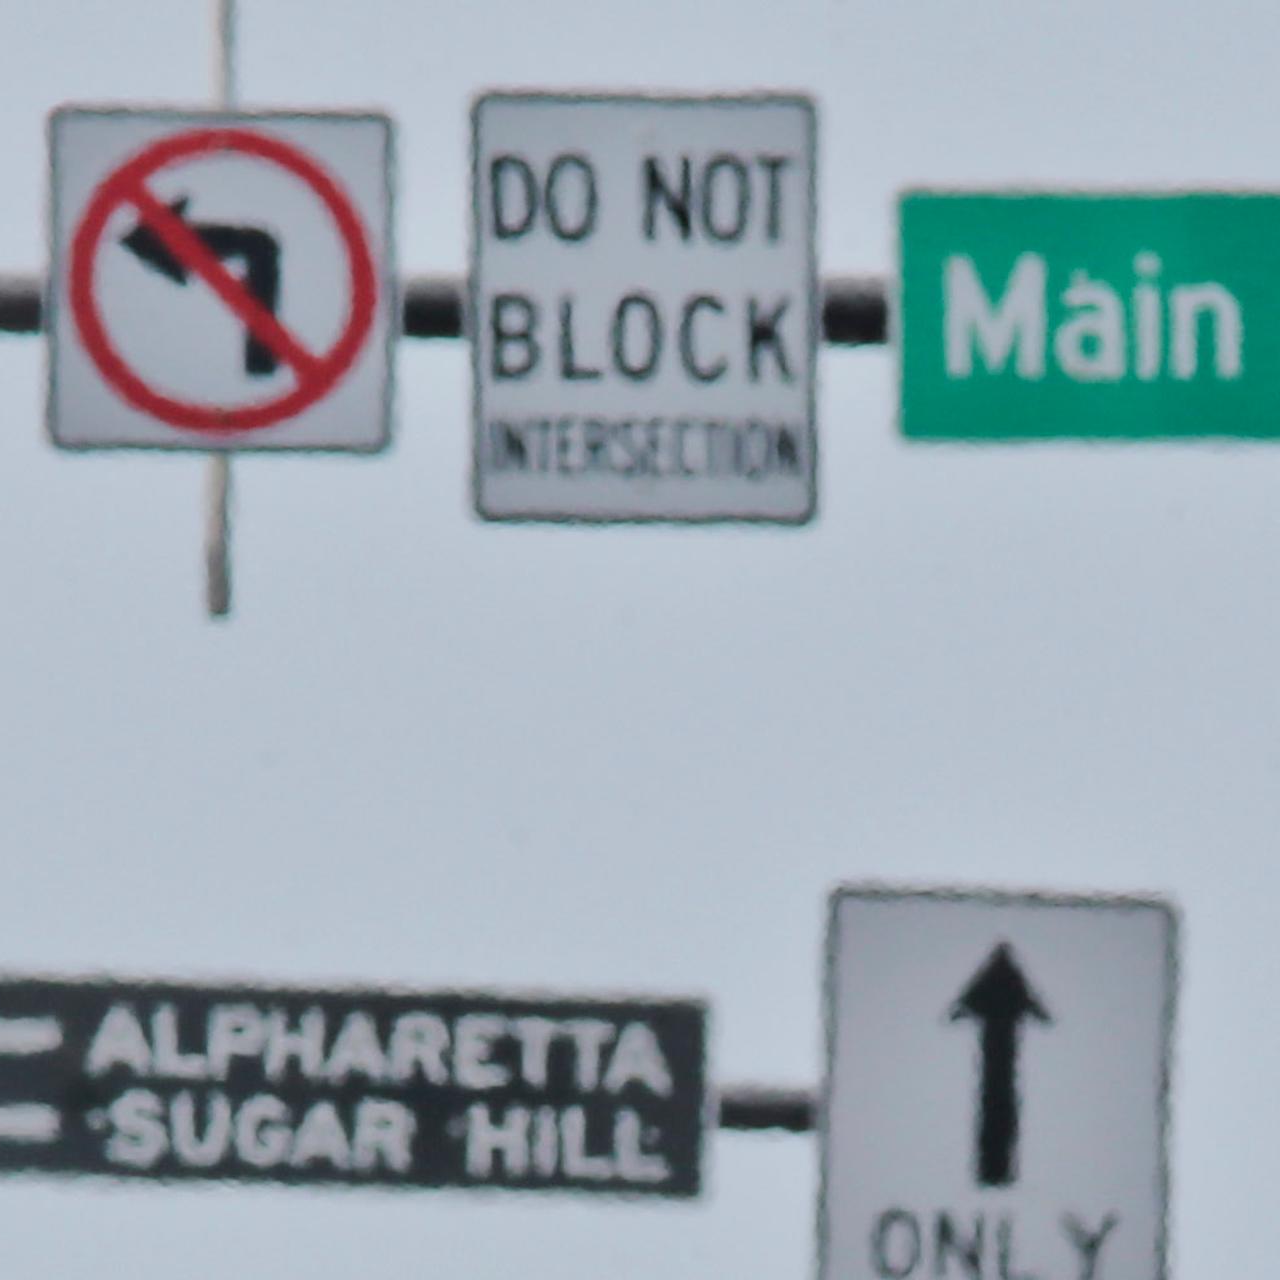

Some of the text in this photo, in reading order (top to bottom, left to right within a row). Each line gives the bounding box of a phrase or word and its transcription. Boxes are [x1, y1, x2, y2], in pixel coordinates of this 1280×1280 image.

[490, 153, 795, 244] DO NOT
[489, 292, 798, 384] BLOCK
[942, 250, 1244, 382] Main
[489, 420, 802, 479] INTERSECTION
[84, 1002, 674, 1097] ALPHARETTA
[105, 1089, 670, 1184] SUGAR HILL
